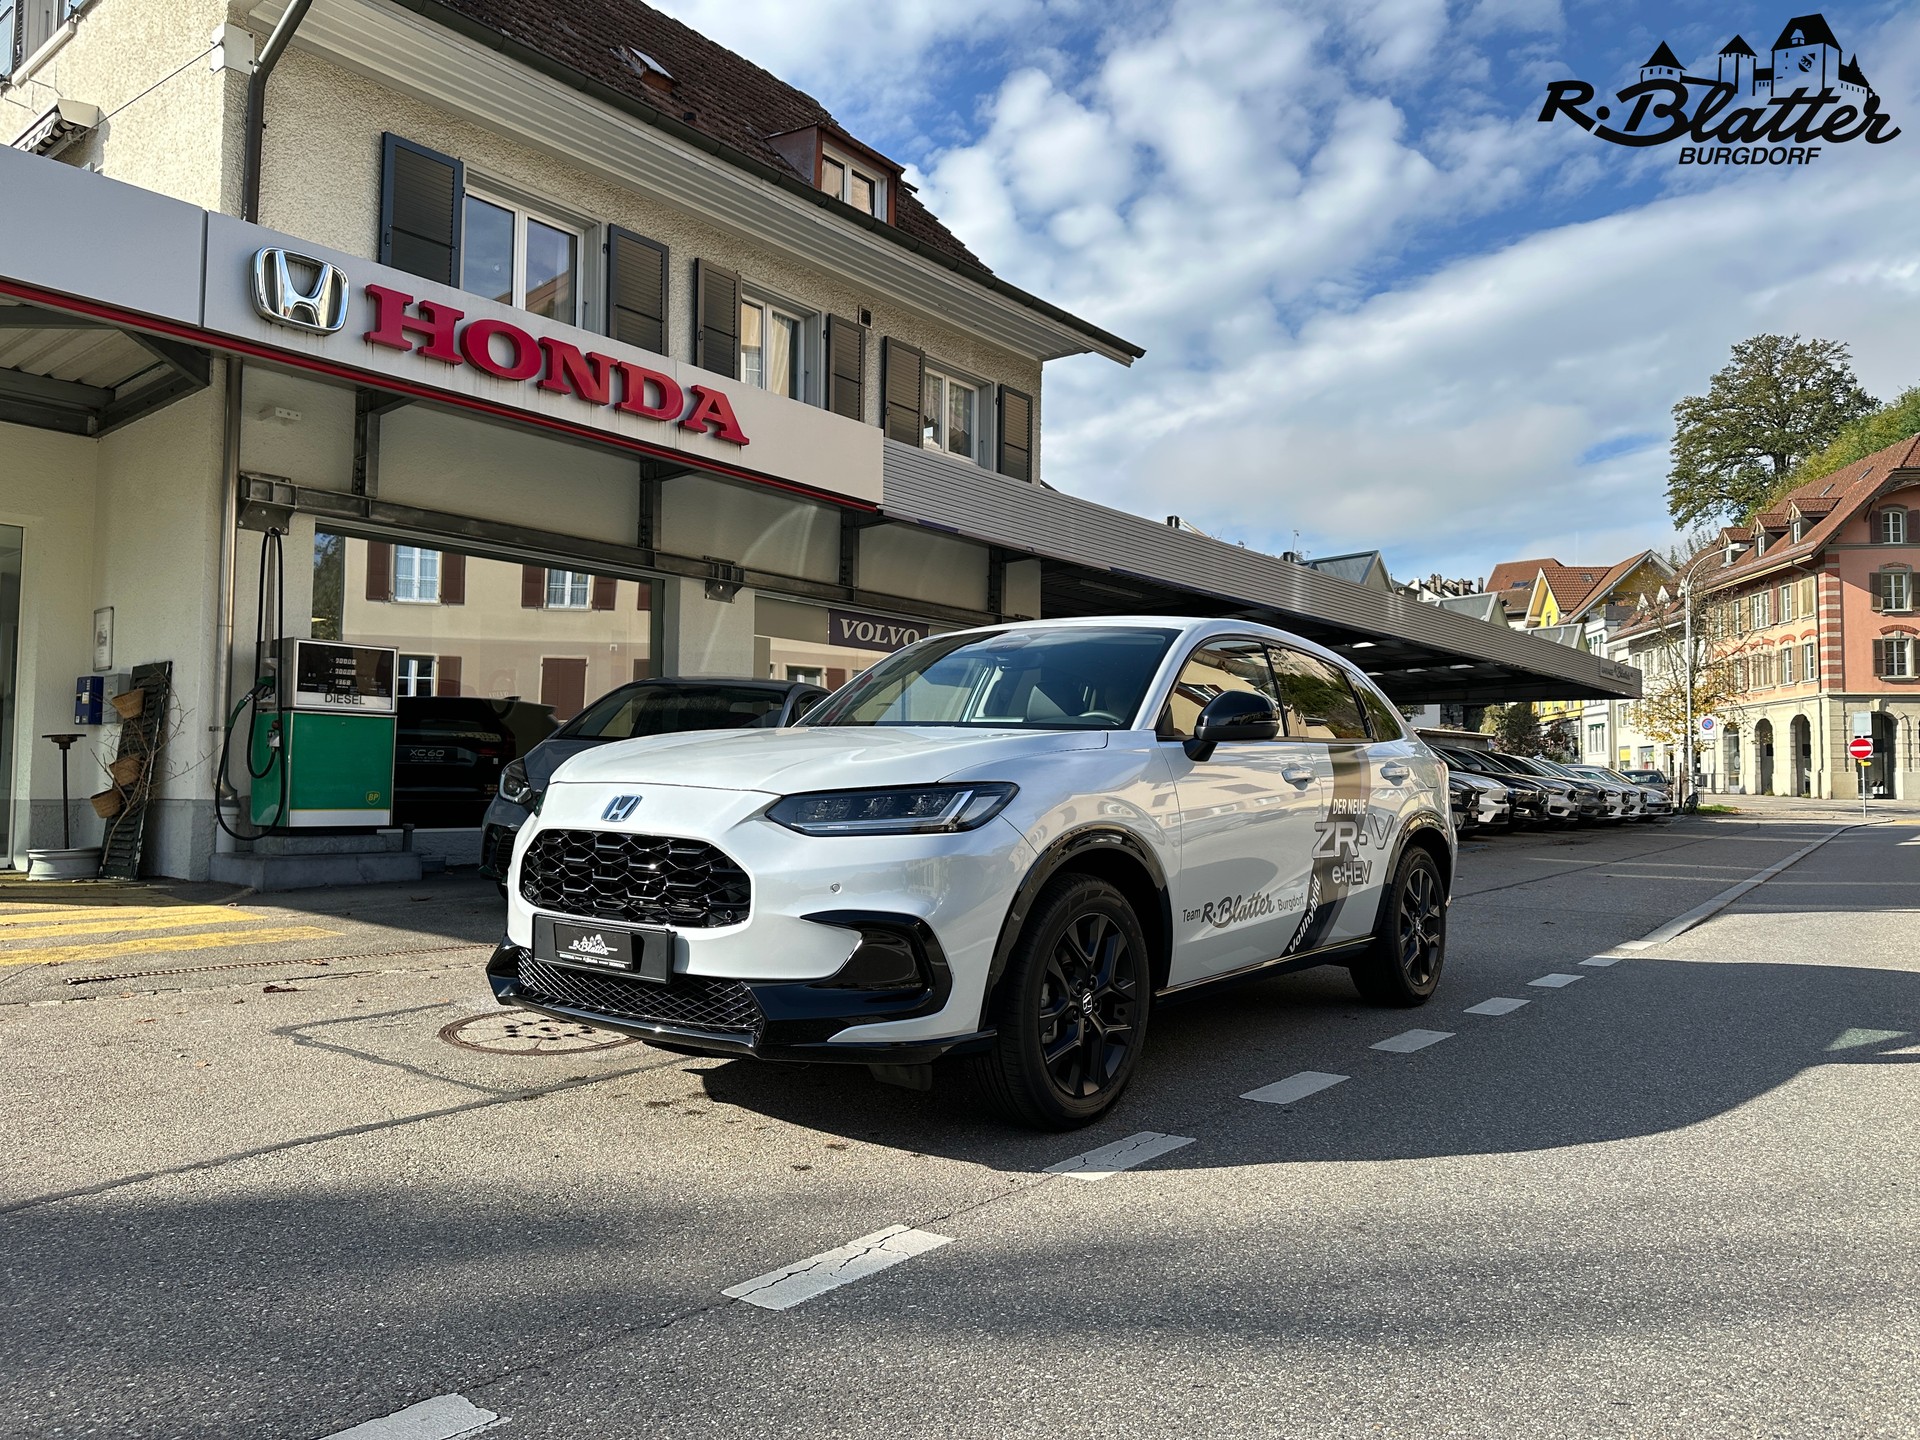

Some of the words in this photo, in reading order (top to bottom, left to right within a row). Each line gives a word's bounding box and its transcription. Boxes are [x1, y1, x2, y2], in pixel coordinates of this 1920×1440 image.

[363, 283, 750, 446] HONDA
[840, 618, 920, 646] VOLVO
[324, 693, 366, 705] DIESEL
[368, 793, 379, 801] BP
[1332, 798, 1348, 815] DER
[1347, 798, 1367, 815] NEUE
[1312, 813, 1395, 859] ZR-V
[1332, 860, 1373, 886] e:HEV
[1182, 908, 1201, 923] Team
[1277, 892, 1305, 911] Burgdorf
